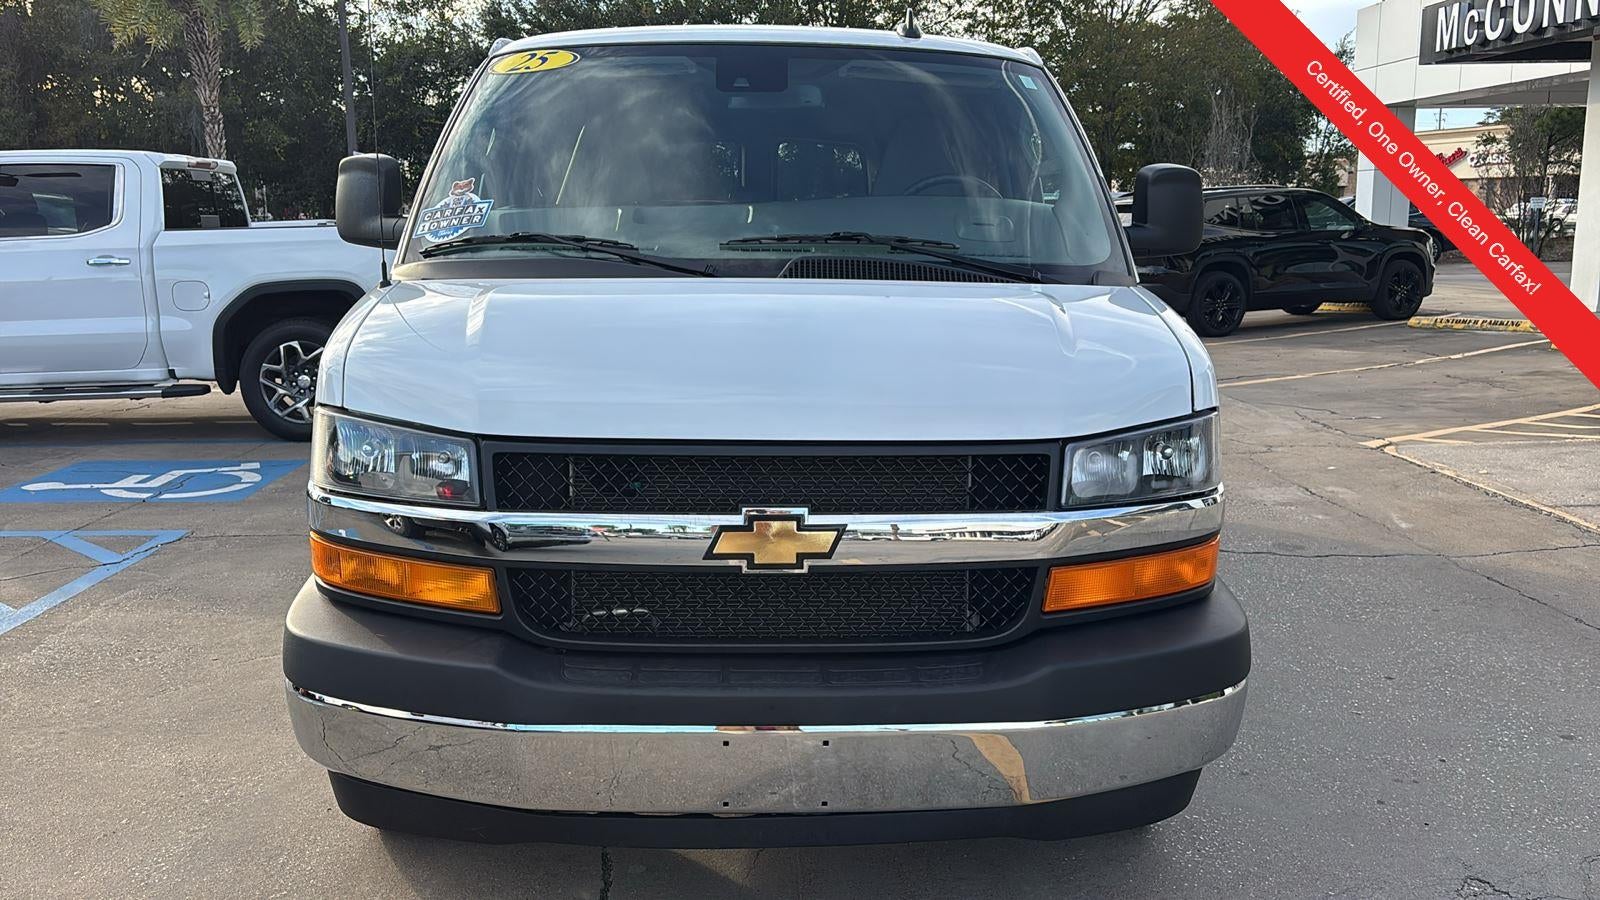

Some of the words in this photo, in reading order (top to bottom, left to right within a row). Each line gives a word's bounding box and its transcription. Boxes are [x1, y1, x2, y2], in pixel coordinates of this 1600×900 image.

[505, 51, 561, 73] 25
[424, 206, 487, 221] CARFAX
[430, 215, 482, 230] OWNER
[1434, 317, 1480, 326] CUSTOMER
[1480, 319, 1522, 328] PARKING
